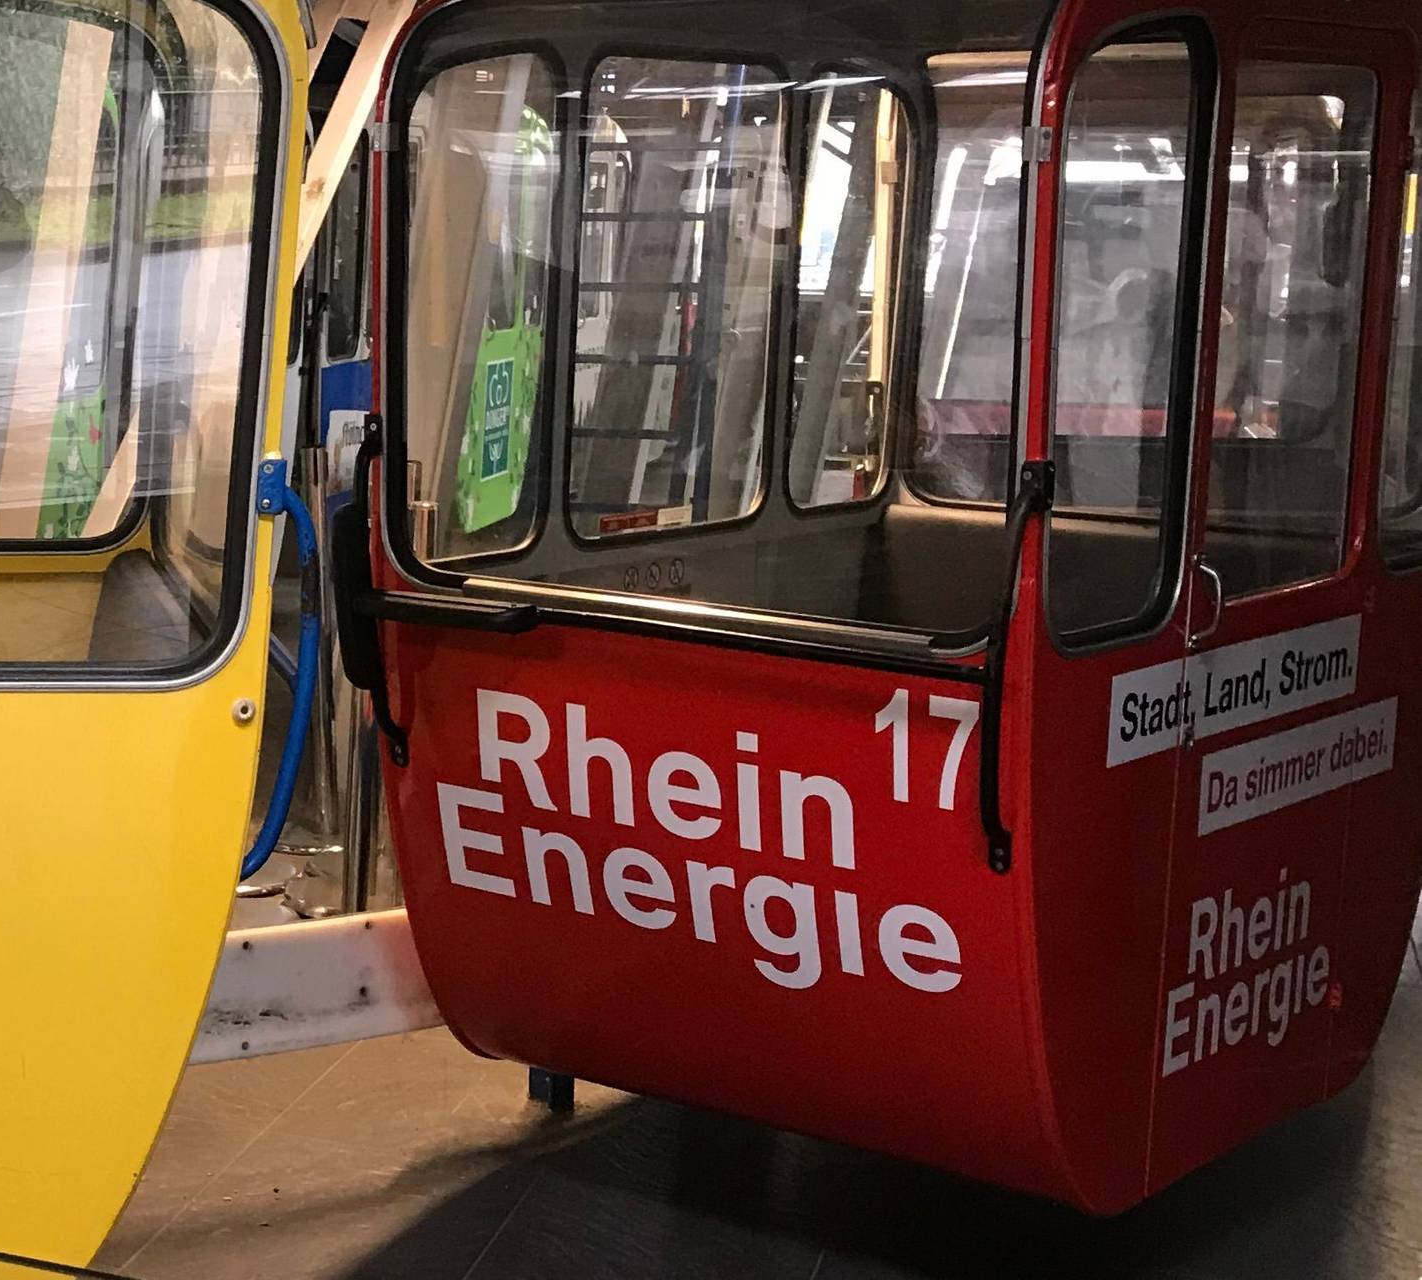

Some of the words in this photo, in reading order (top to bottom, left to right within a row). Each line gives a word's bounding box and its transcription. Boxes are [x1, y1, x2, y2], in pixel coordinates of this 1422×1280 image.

[875, 688, 980, 811] 17
[1120, 680, 1195, 742] Stadt,
[1204, 658, 1271, 717] Land,
[1280, 647, 1353, 696] Strom.
[477, 688, 855, 870] Rhein
[1207, 771, 1238, 813] Da
[1245, 746, 1326, 801] simmer
[1330, 719, 1388, 772] dabei.
[436, 782, 963, 993] Energie
[1188, 867, 1312, 980] Rhein
[1162, 945, 1330, 1077] Energie
